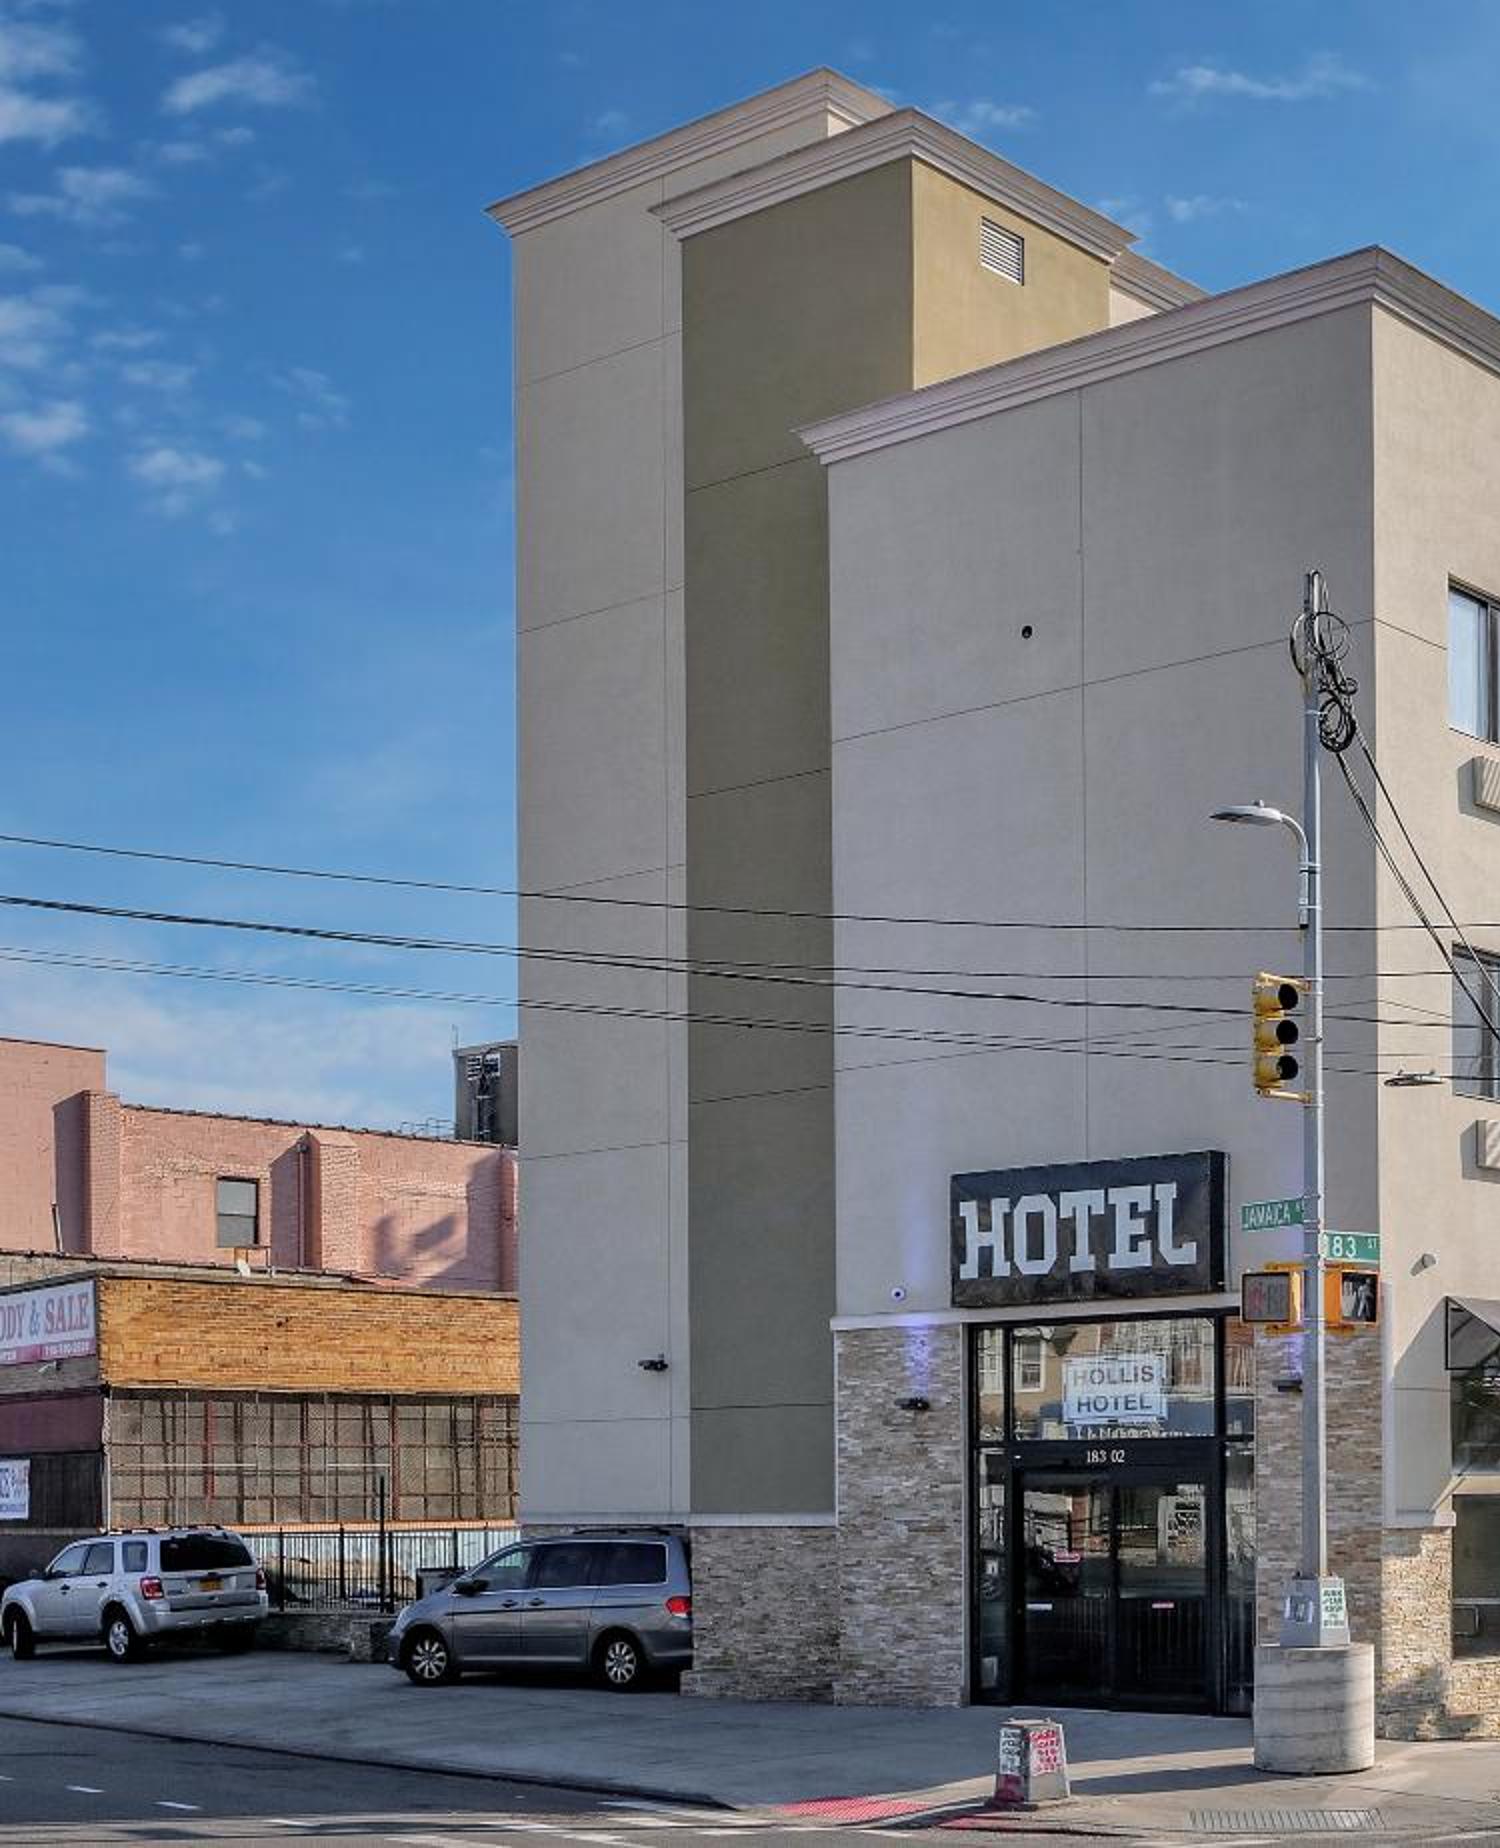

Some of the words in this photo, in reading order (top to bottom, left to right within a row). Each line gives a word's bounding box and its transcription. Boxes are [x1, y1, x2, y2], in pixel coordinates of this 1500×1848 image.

[1244, 1201, 1291, 1227] JAMAICA
[960, 1182, 1197, 1280] HOTEL
[1321, 1235, 1357, 1258] 83
[1367, 1236, 1377, 1249] ST
[29, 1298, 41, 1337] &
[45, 1291, 89, 1334] SALE
[1073, 1365, 1154, 1386] HOLLIS
[1077, 1393, 1153, 1413] HOTEL
[1087, 1449, 1107, 1463] 183
[1111, 1449, 1125, 1463] 02
